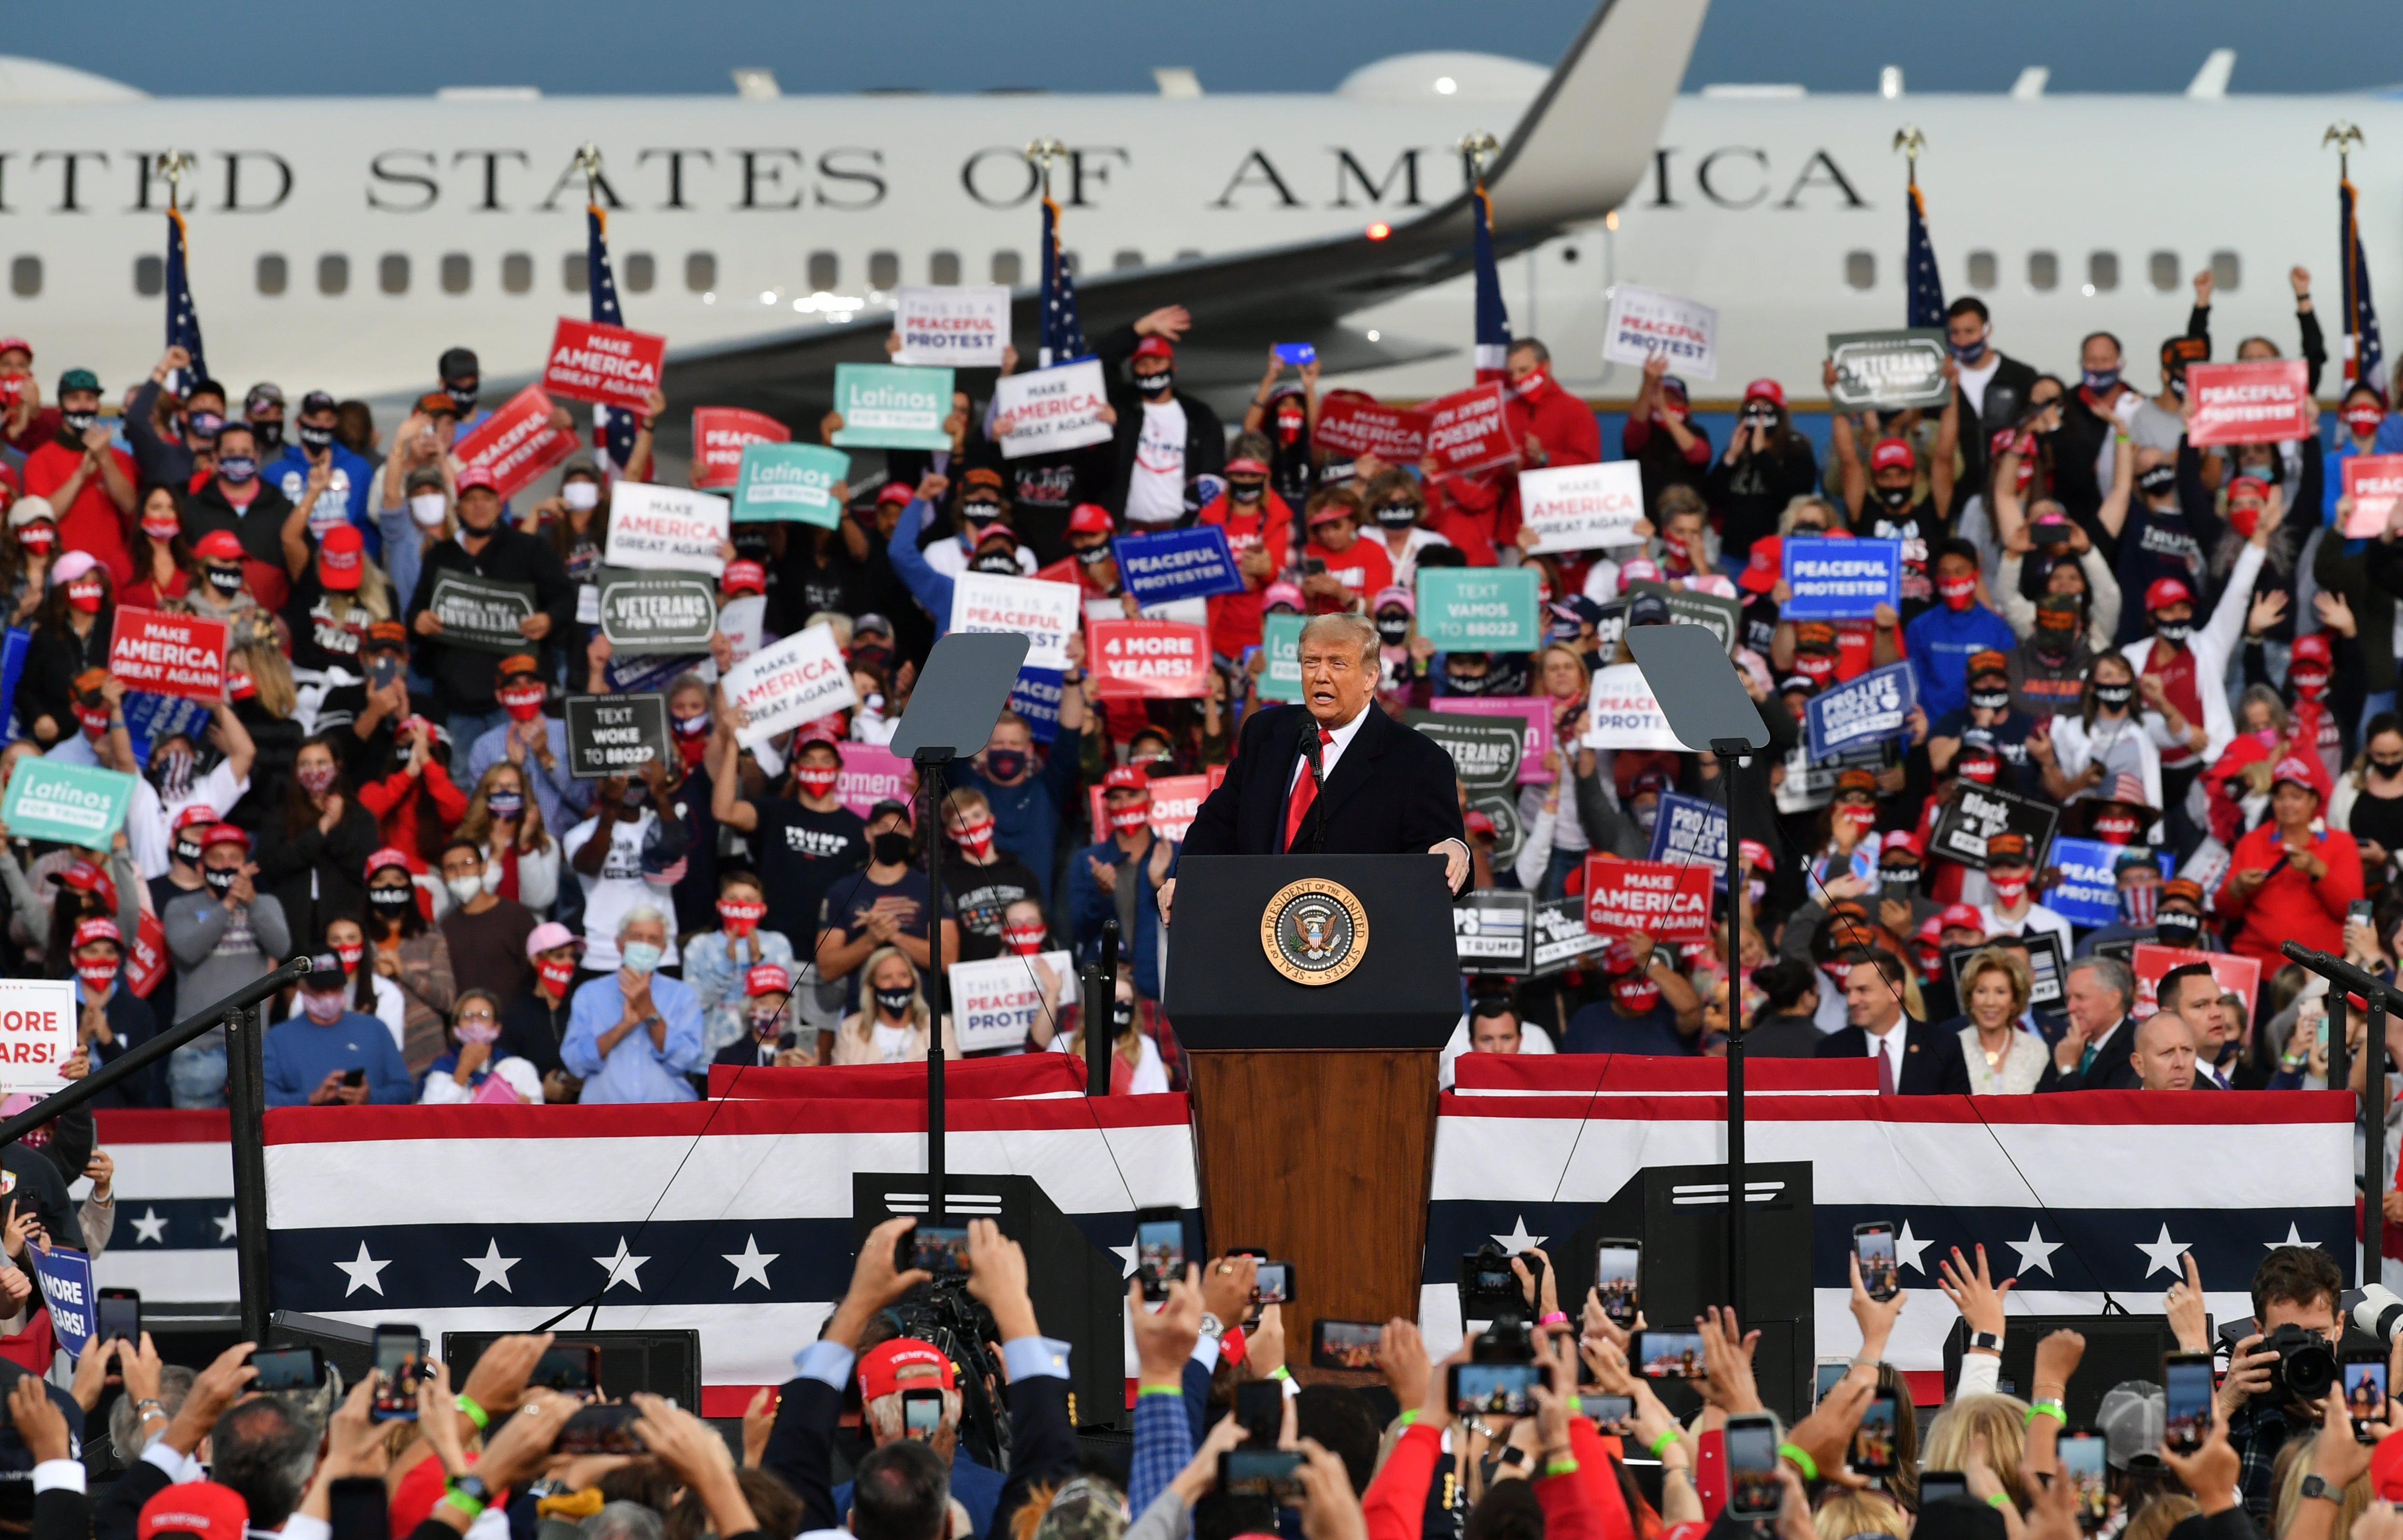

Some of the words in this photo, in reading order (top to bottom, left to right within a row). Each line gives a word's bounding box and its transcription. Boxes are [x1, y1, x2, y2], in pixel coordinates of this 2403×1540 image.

[365, 148, 888, 213] STATES
[959, 146, 1132, 212] OF
[1205, 145, 1875, 212] AMICA
[907, 316, 995, 331] PEACEFUL
[1622, 316, 1706, 344] PEACEFUL
[587, 335, 632, 356] MAKE
[906, 332, 995, 348] PROTEST
[1618, 331, 1706, 360] PROTEST
[554, 346, 655, 383] AMERICA
[549, 365, 601, 389] GREAT
[850, 383, 938, 409] Latinos
[1028, 382, 1067, 397] MAKE
[2200, 384, 2295, 403] PEACEFUL
[1004, 392, 1099, 421] AMERICA
[1321, 417, 1423, 445] AMERICA
[750, 462, 830, 486] Latinos
[649, 500, 693, 516] MAKE
[1531, 493, 1634, 518] AMERICA
[617, 515, 720, 541] AMERICA
[615, 534, 665, 554] GREAT
[1127, 547, 1220, 574] PEACEFUL
[1793, 560, 1888, 577] PEACEFUL
[1134, 564, 1225, 592] PROTESTER
[1457, 584, 1499, 598] TEXT
[1794, 581, 1888, 597] PROTESTER
[615, 597, 707, 618] VETERANS
[1449, 603, 1509, 618] VAMOS
[967, 607, 1061, 630] PEACEFUL
[1440, 622, 1461, 636] TO
[145, 623, 190, 645] MAKE
[114, 636, 219, 670] AMERICA
[1105, 640, 1121, 656] 4
[1125, 638, 1193, 655] MORE
[112, 660, 163, 681] GREAT
[166, 670, 220, 688] AGAIN
[754, 651, 797, 676] MAKE
[1107, 658, 1192, 677] YEARS!
[736, 658, 837, 706] AMERICA
[795, 680, 843, 706] AGAIN
[595, 708, 632, 722] TEXT
[593, 728, 640, 744] WOKE
[585, 748, 602, 764] TO
[1447, 742, 1511, 763] TERANS
[23, 775, 112, 810] Latinos
[836, 773, 900, 794] omen
[1152, 799, 1199, 818] ORE
[785, 826, 848, 847] TRUMP
[1327, 886, 1341, 896] THE
[1624, 873, 1674, 891] MAKE
[1265, 882, 1312, 929] PRESIDENT
[1593, 889, 1705, 912] AMERICA
[1343, 895, 1365, 938] UNITED
[1455, 909, 1479, 935] PS
[1592, 910, 1644, 927] GREAT
[1649, 913, 1704, 929] AGAIN
[1266, 933, 1274, 948] THE
[1465, 939, 1522, 953] TRUMP
[1270, 950, 1279, 959] OF
[1325, 948, 1360, 980] STATES
[1279, 958, 1305, 980] SEAL
[967, 992, 1039, 1010] PEACEF
[969, 1009, 1037, 1030] PROTE
[46, 1277, 83, 1305] MORE
